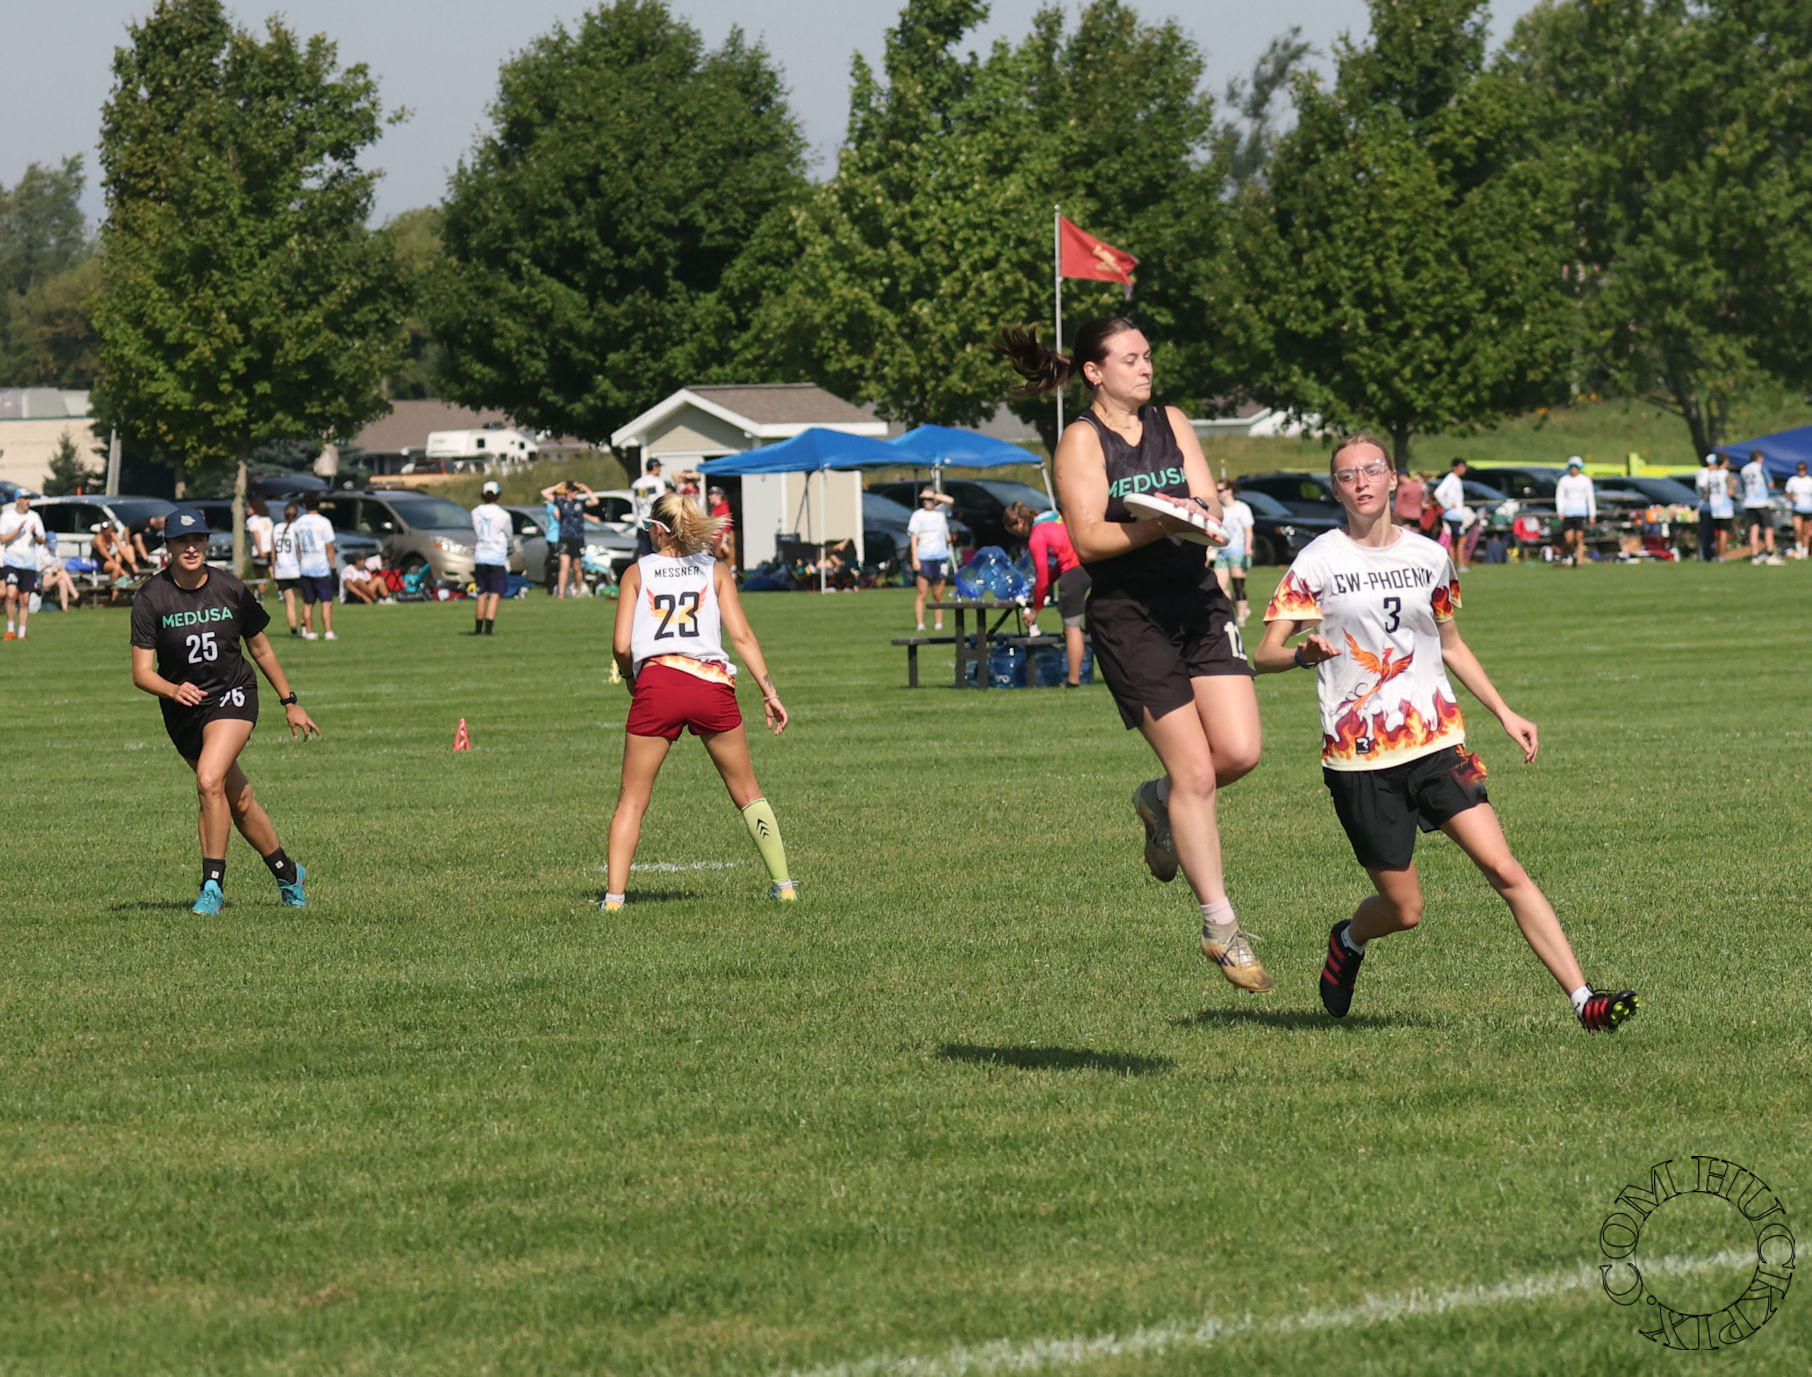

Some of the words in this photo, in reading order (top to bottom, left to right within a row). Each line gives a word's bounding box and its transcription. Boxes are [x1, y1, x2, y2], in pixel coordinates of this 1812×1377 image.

[654, 565, 700, 578] MESSNER
[162, 606, 233, 629] MEDUSA
[654, 591, 700, 641] 23
[1383, 596, 1401, 634] 3
[185, 631, 218, 664] 25
